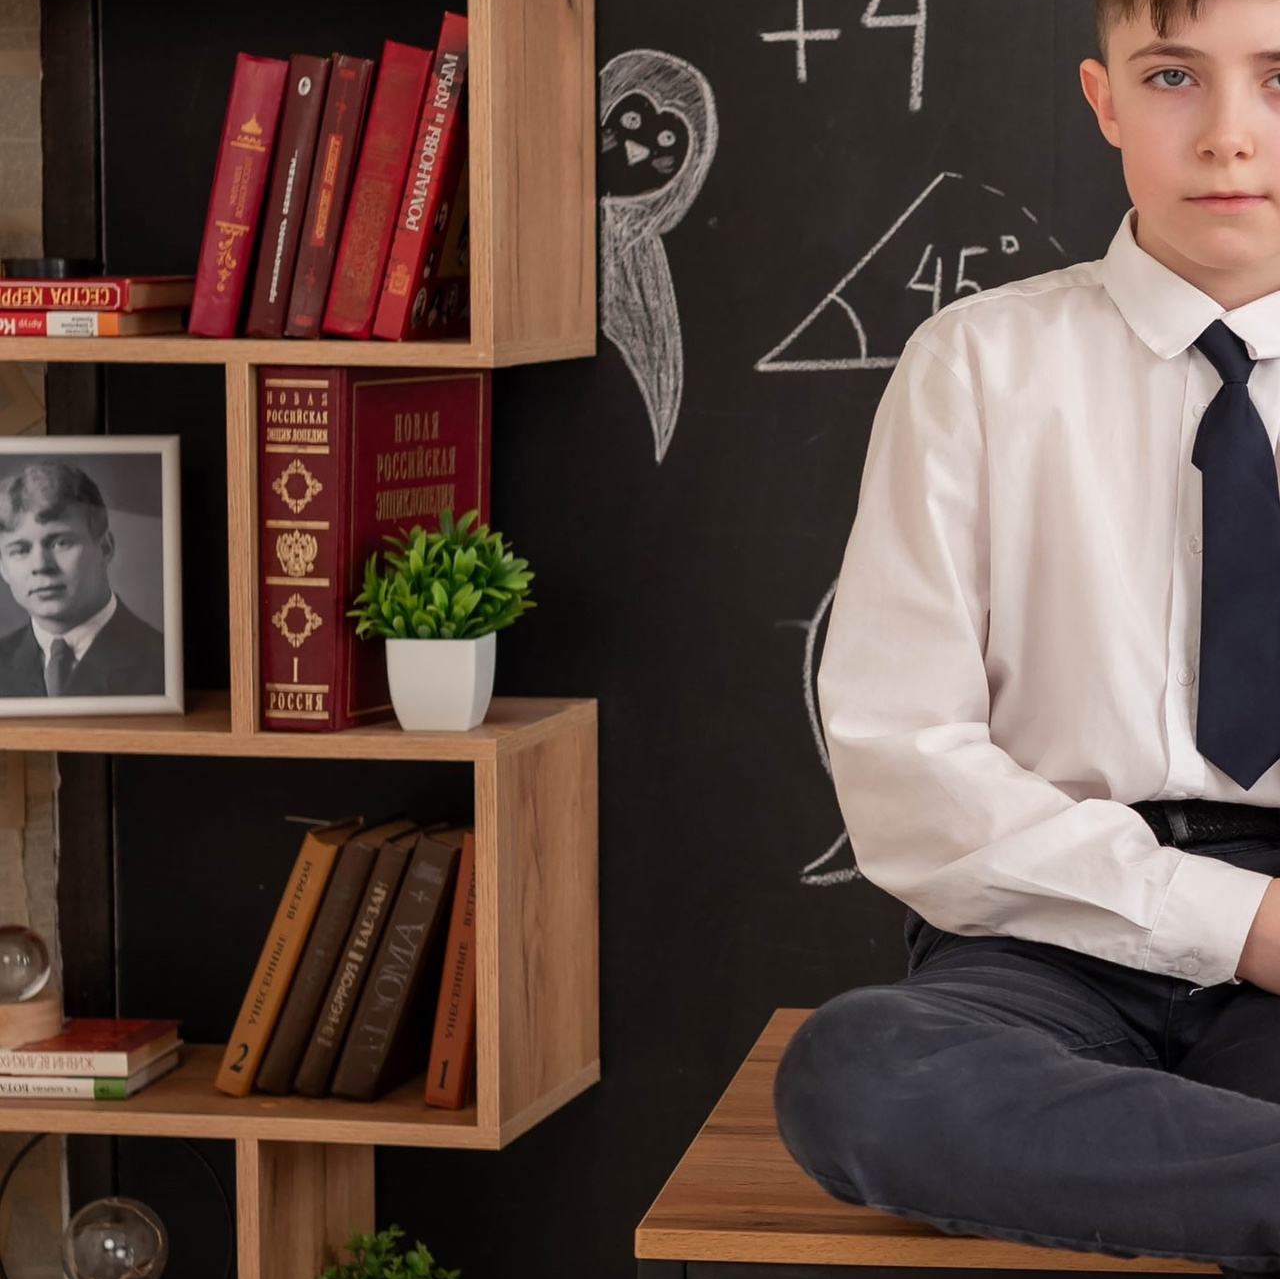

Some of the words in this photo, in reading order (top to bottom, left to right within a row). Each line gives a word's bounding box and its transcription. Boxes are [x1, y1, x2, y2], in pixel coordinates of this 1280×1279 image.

[405, 124, 443, 233] РОМАНОВЫ
[433, 52, 459, 110] КРЫМ
[51, 287, 110, 306] СЕСТРА
[265, 408, 328, 425] РОССИЙСКАЯ
[394, 410, 440, 444] НОВАЯ
[266, 428, 328, 444] ЭНЦИКЛОПЕДИЯ
[376, 445, 456, 484] РОССИЙСКАЯ
[375, 482, 456, 524] ЭНЦИКЛОПЕДИЯ
[269, 691, 324, 712] РОССИЯ
[286, 860, 313, 921] ВЕТРОМ
[229, 1043, 249, 1072] 2
[438, 1059, 449, 1089] 1
